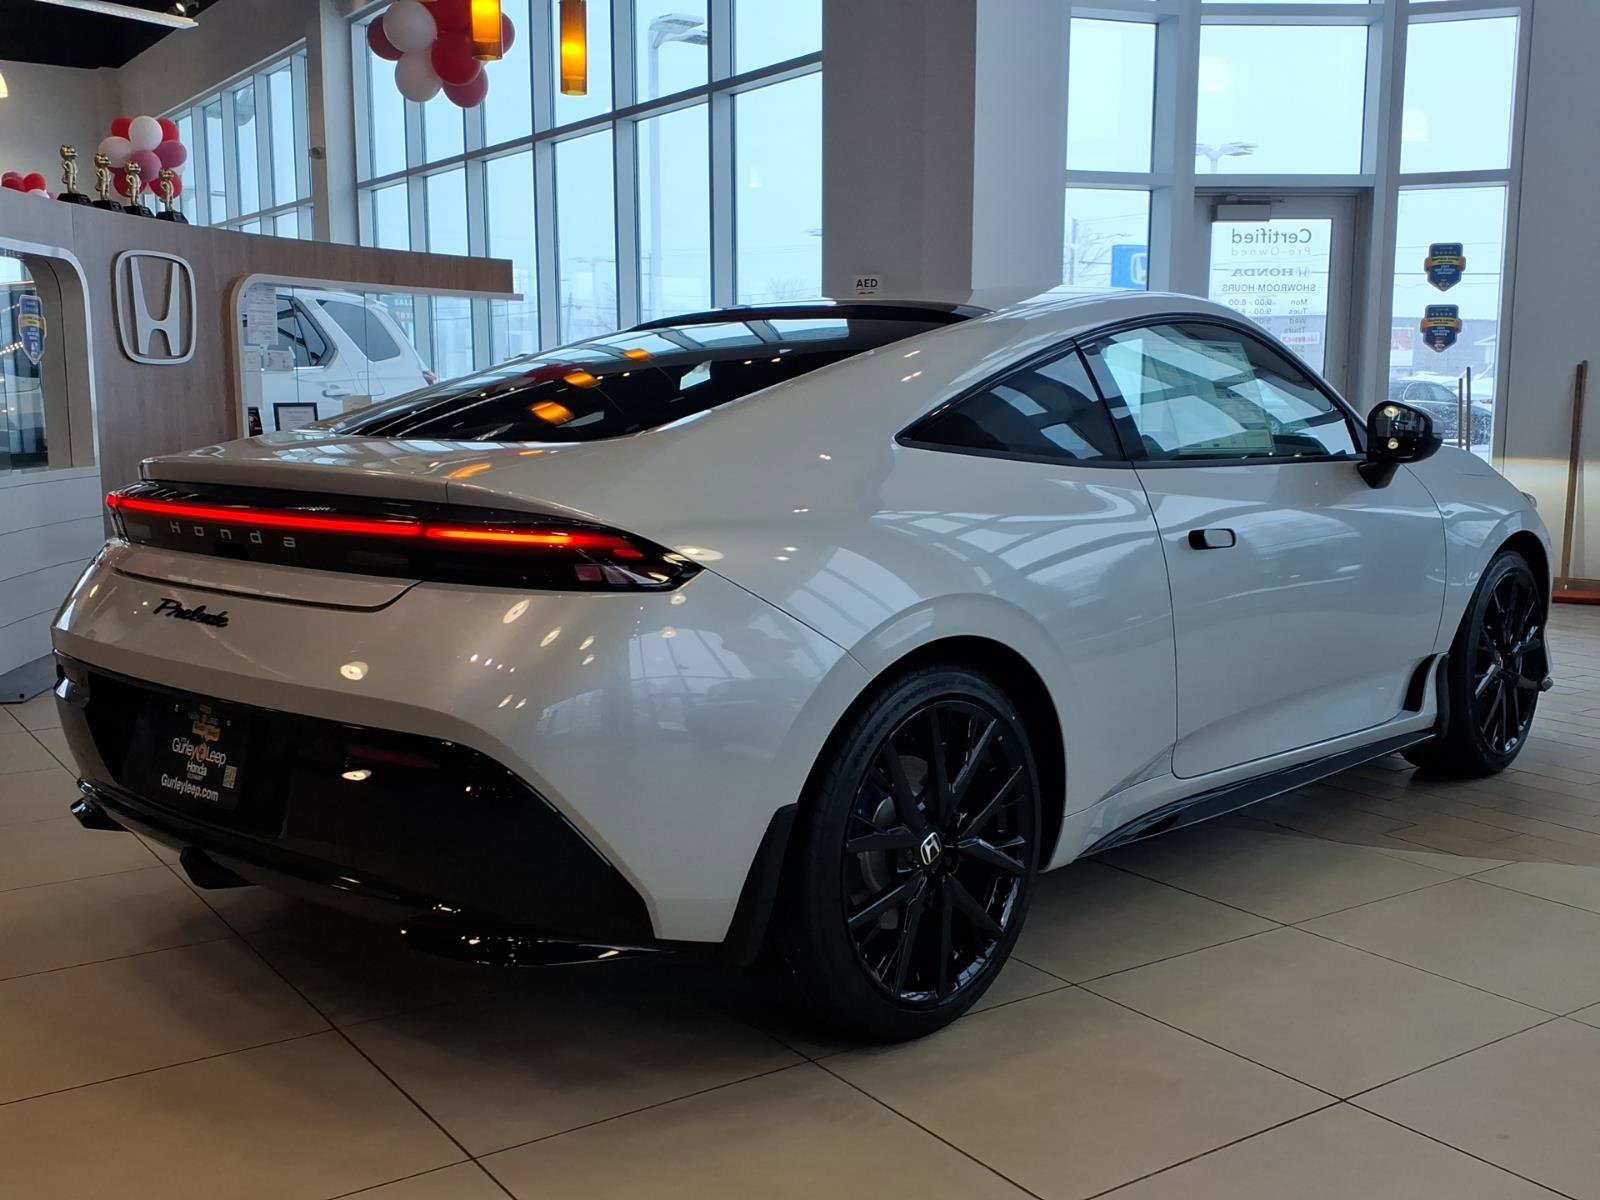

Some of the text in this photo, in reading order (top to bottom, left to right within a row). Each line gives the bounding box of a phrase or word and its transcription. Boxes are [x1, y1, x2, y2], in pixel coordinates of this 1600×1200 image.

[855, 278, 878, 288] AED
[152, 598, 230, 628] Prelude
[172, 738, 227, 768] Gurley Leep
[186, 760, 208, 777] Honda
